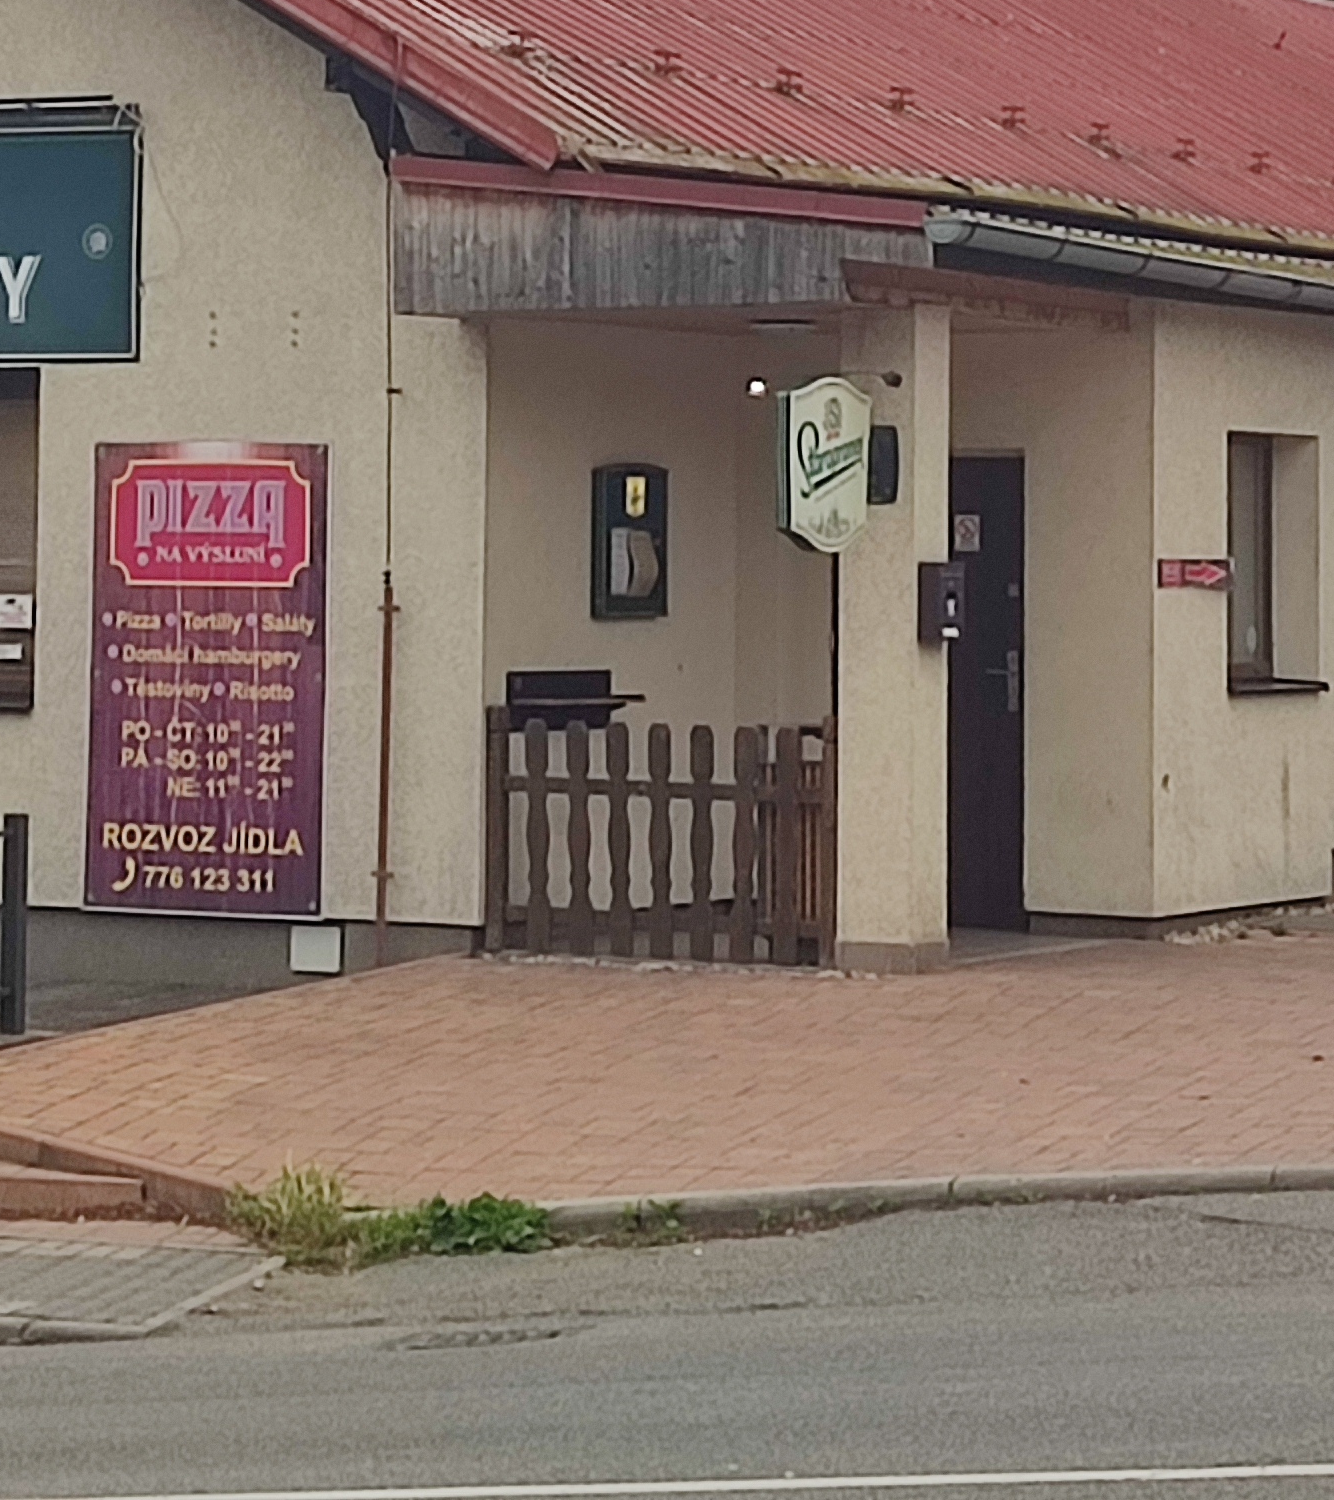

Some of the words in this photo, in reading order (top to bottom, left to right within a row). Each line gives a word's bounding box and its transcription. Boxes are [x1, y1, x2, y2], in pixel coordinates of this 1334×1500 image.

[134, 479, 286, 548] PIZZA
[155, 546, 182, 563] NA
[116, 610, 161, 631] Pizza
[183, 611, 243, 636] Tortilly
[193, 646, 302, 670] hamburgery
[229, 680, 295, 701] Risotto
[121, 720, 151, 742] PO
[102, 822, 216, 854] ROZVOZ
[223, 820, 304, 856] JÍDLA
[142, 865, 183, 889] 776
[190, 868, 231, 892] 123
[236, 869, 274, 893] 311
